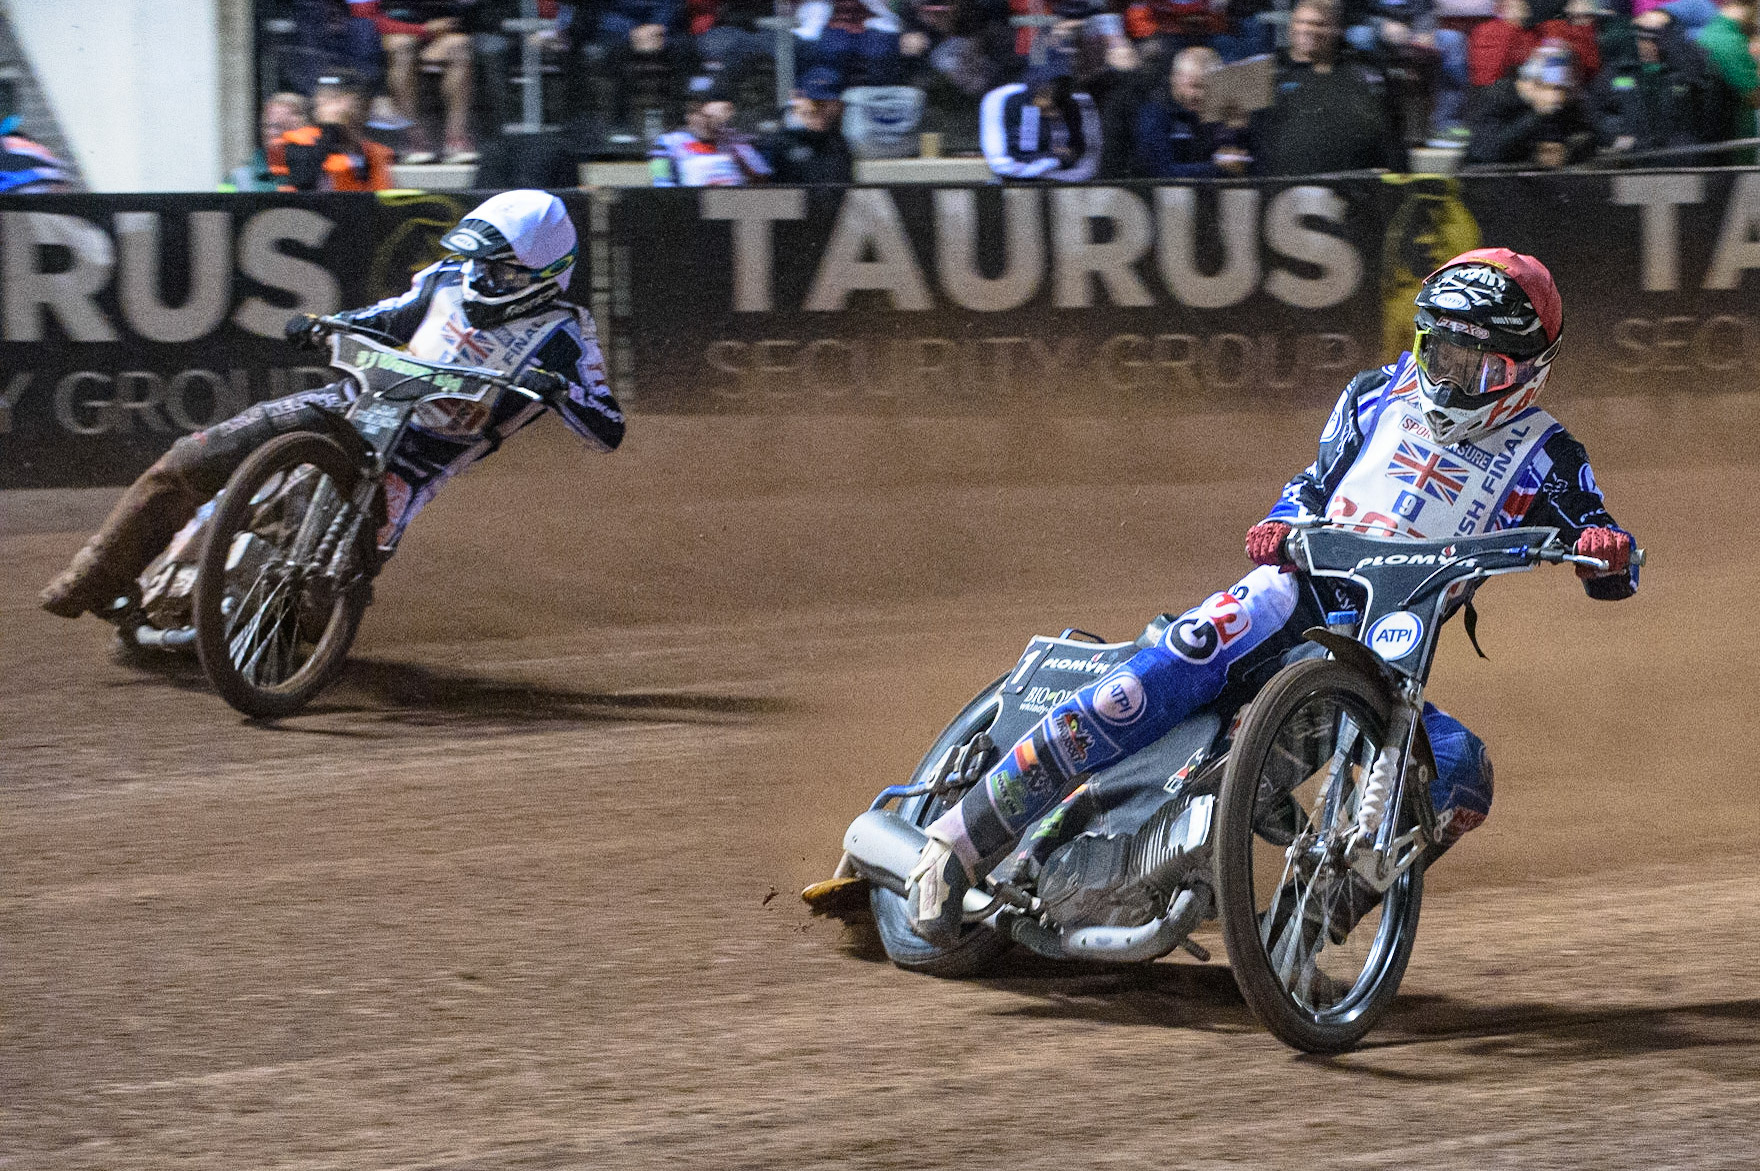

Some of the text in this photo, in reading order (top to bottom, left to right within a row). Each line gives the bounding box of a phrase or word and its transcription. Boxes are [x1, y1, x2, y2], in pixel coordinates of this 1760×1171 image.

[700, 187, 1365, 311] TAURUS
[0, 207, 341, 343] RUS
[503, 319, 547, 366] FINAL
[704, 331, 1357, 398] SECURITY GROUP
[1402, 418, 1432, 440] SPOR
[1481, 425, 1531, 495] FINAL
[1398, 494, 1417, 517] 9
[1375, 628, 1413, 643] ATPI
[1011, 650, 1041, 685] 1
[1109, 683, 1133, 713] ATPI
